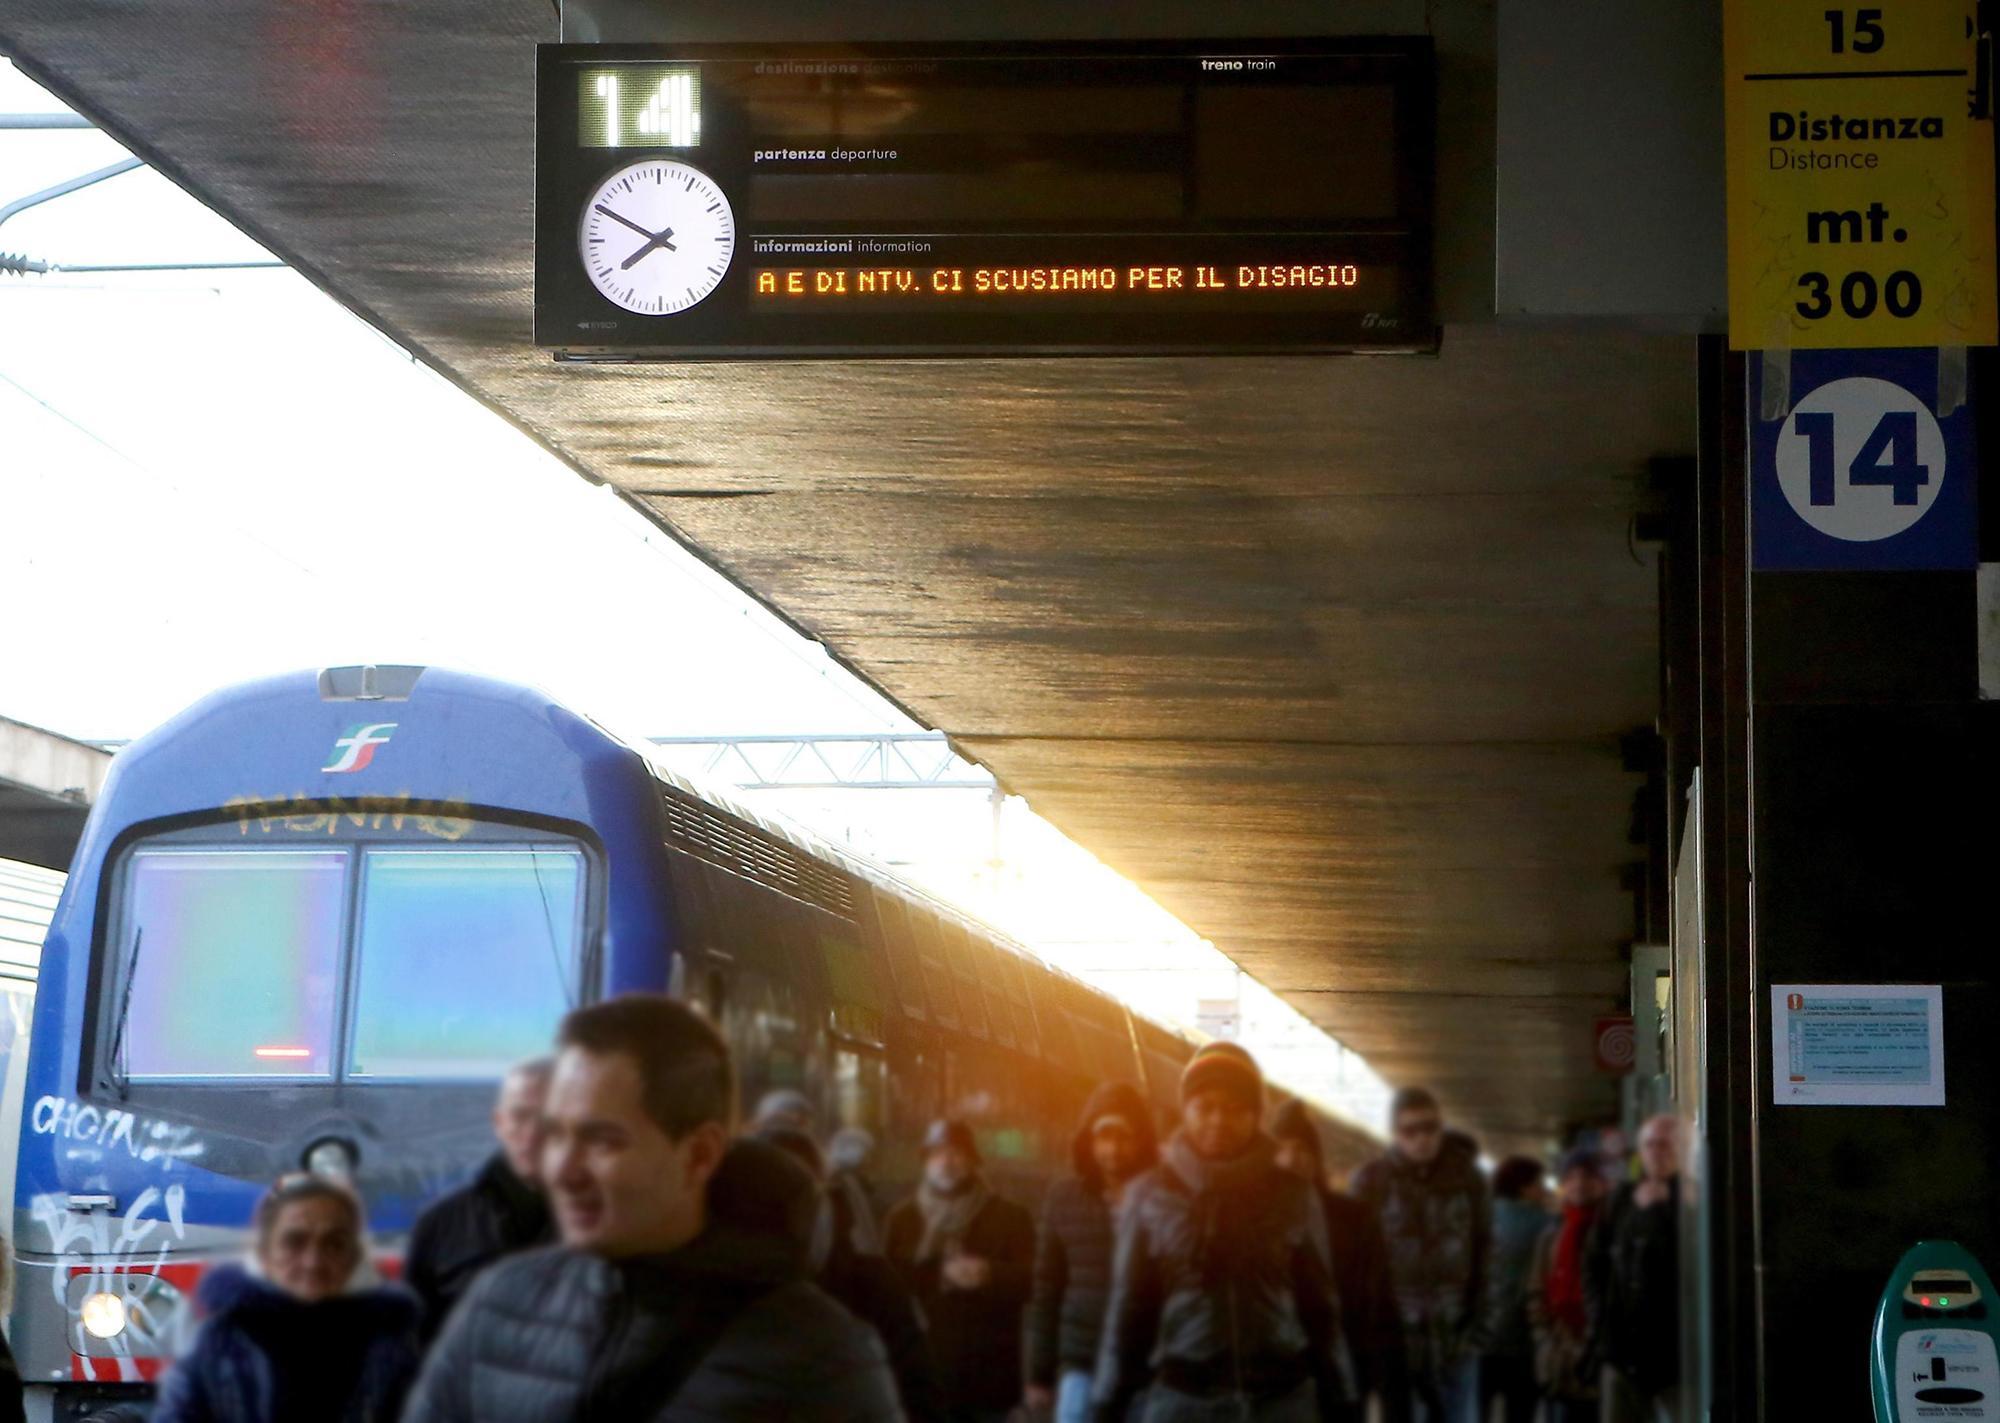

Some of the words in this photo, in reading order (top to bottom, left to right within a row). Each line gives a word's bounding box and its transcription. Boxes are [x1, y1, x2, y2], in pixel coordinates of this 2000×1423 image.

[1824, 8, 1885, 54] 15
[754, 61, 859, 75] destinazione
[1201, 58, 1244, 71] treno
[1247, 58, 1276, 71] train
[596, 74, 700, 148] 14
[1769, 111, 1944, 141] Distanza
[754, 147, 826, 163] partenza
[831, 147, 897, 163] departure
[1769, 146, 1879, 171] Distance
[1807, 202, 1908, 244] mt.
[754, 239, 853, 252] informazioni
[858, 239, 931, 252] information
[758, 271, 776, 293] A
[787, 271, 804, 293] E
[816, 271, 847, 293] DI
[858, 270, 920, 292] NTV.
[932, 270, 963, 292] CI
[974, 268, 1116, 292] SCUSIAMO
[1128, 267, 1183, 290] PER
[1196, 266, 1226, 288] IL
[1238, 265, 1357, 287] DISAGIO
[1795, 270, 1922, 320] 300
[1795, 411, 1929, 506] 14
